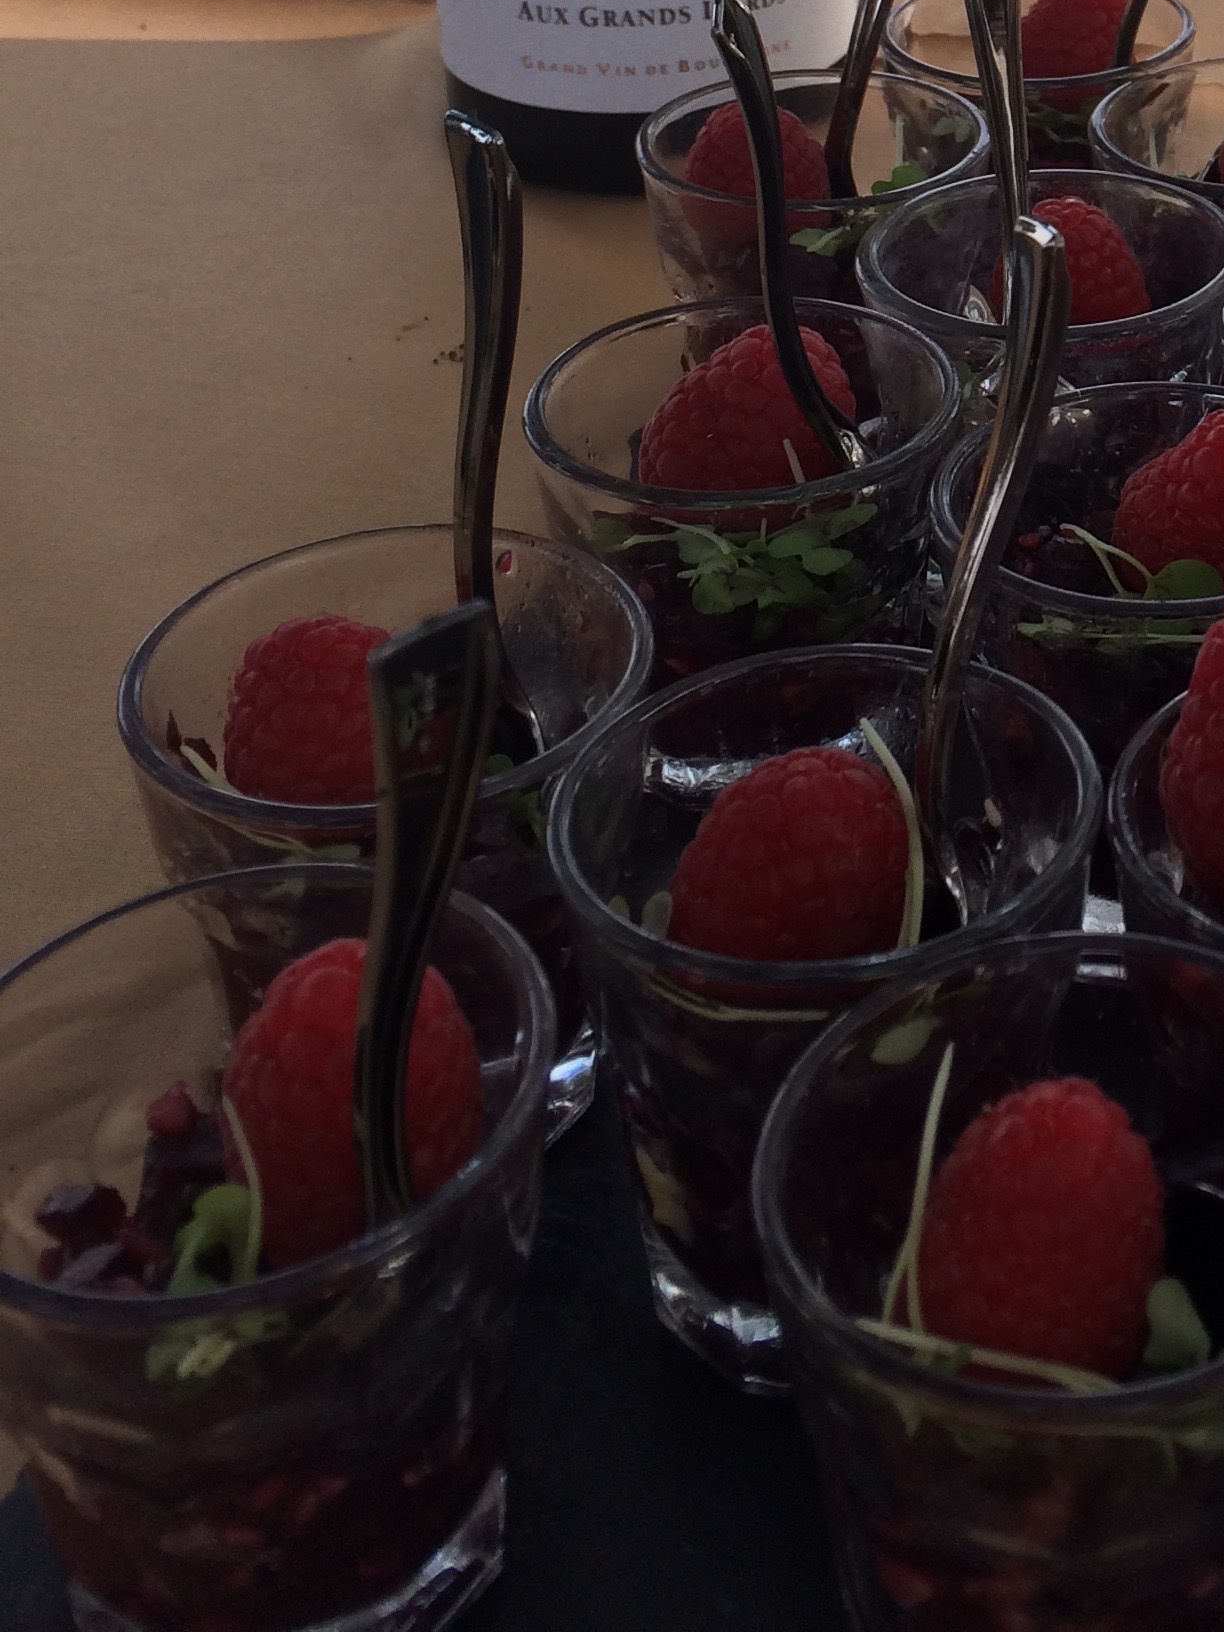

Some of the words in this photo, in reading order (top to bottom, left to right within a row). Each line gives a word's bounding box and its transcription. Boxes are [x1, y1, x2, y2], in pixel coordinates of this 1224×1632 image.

[517, 0, 569, 26] AUX
[579, 5, 692, 28] GRANDS
[520, 54, 588, 77] GRAND
[597, 59, 636, 77] VIN
[644, 63, 670, 76] DE
